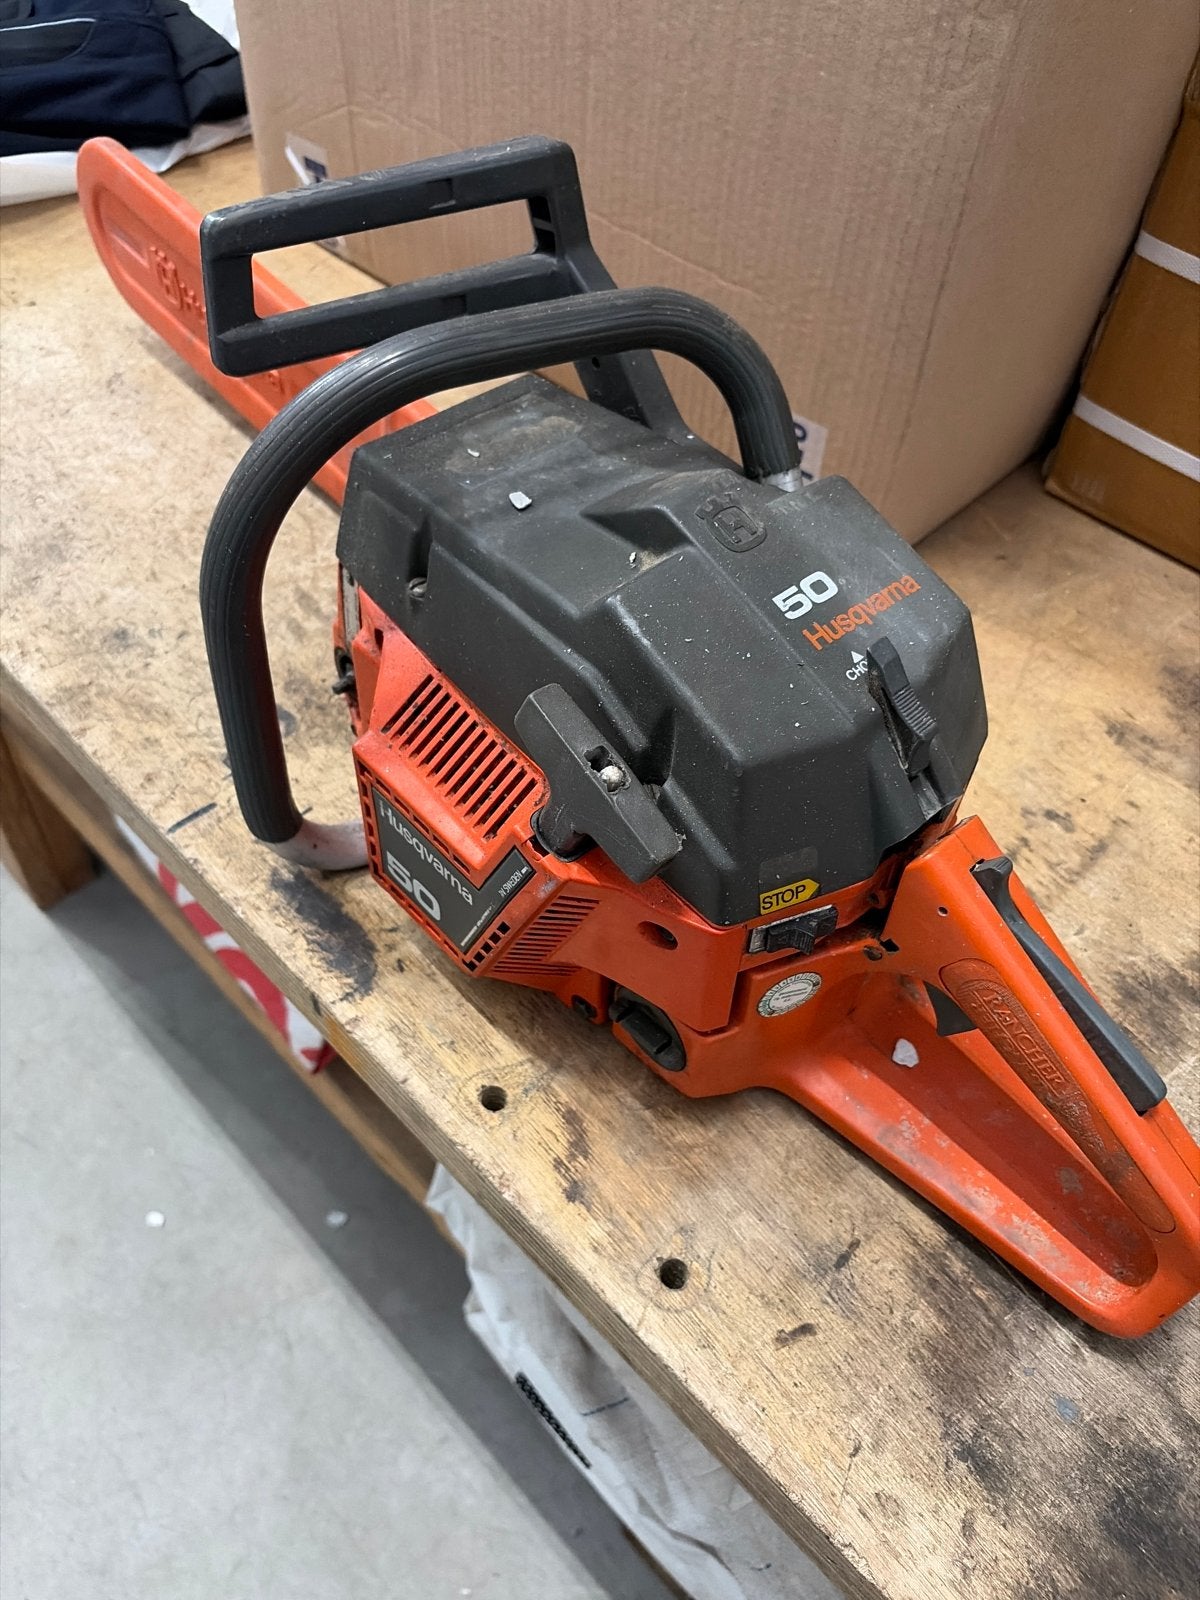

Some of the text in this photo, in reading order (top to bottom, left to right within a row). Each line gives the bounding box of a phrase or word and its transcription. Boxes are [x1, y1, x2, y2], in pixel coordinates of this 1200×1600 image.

[772, 571, 838, 620] 50
[802, 575, 921, 650] Husqvarna
[845, 658, 868, 681] CHO
[379, 799, 473, 906] Husqvarna
[502, 869, 523, 893] SWEDEN
[386, 851, 441, 921] 50
[762, 884, 806, 910] STOP
[983, 990, 1066, 1085] RANCHER
